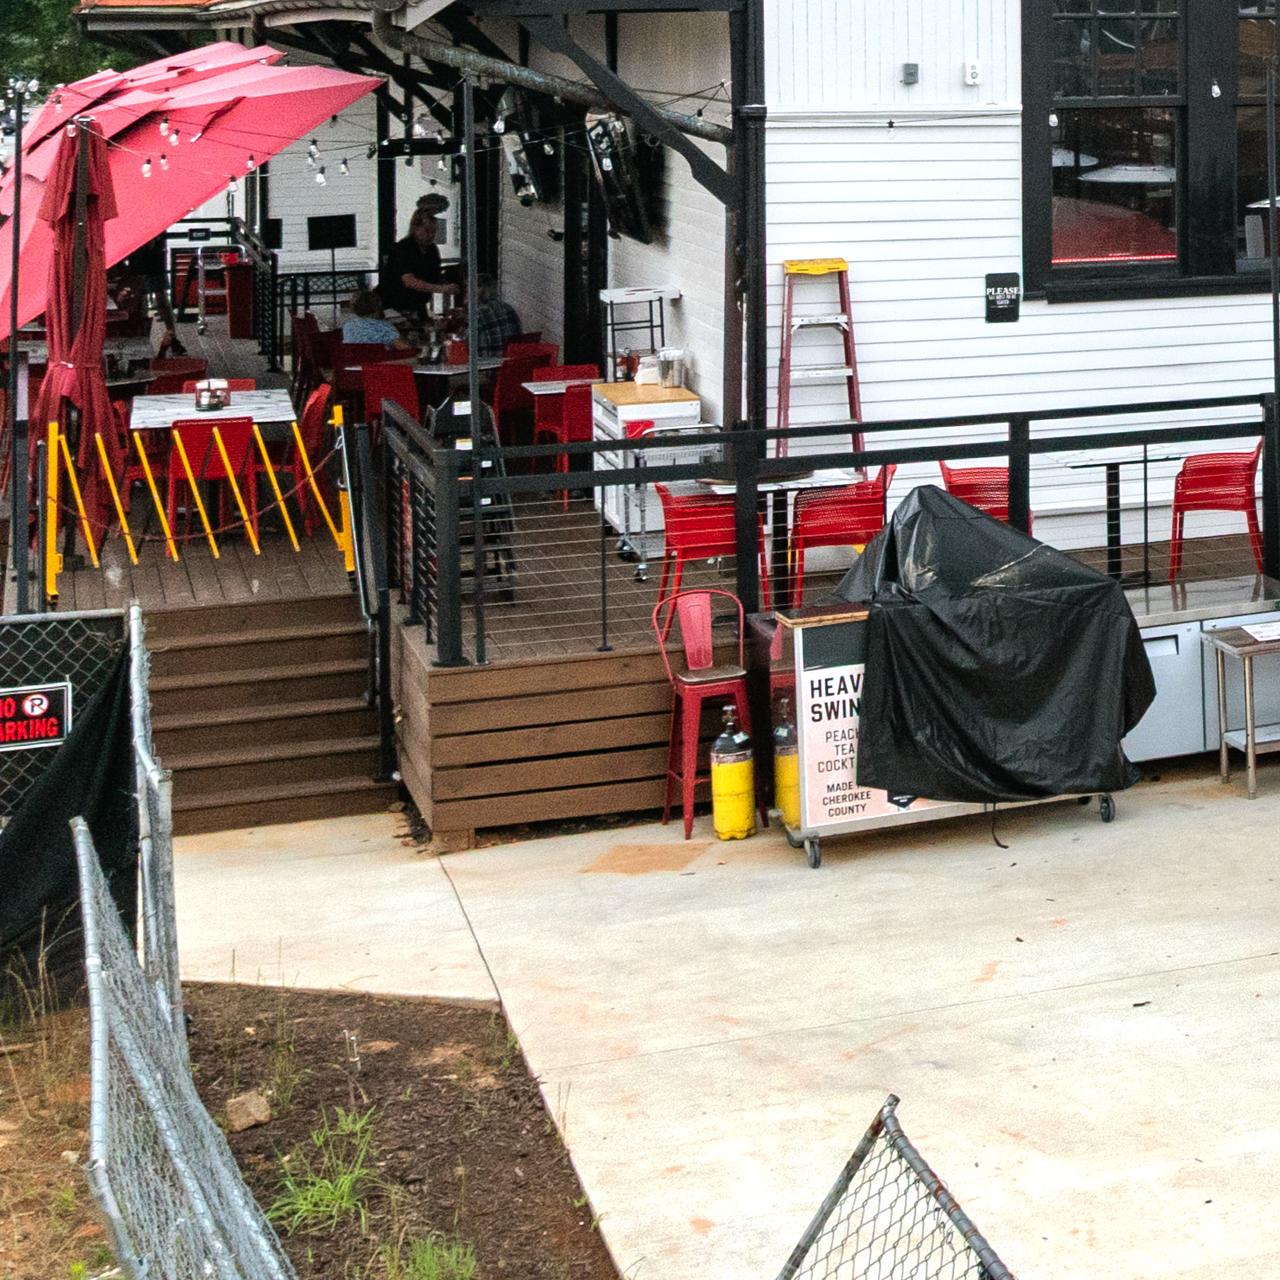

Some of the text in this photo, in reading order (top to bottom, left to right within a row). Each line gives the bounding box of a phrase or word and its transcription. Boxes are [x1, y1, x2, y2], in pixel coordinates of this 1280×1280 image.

[986, 286, 1020, 295] PLEASE
[810, 673, 864, 699] HEAV
[810, 698, 861, 723] SWIN
[0, 717, 58, 741] ARKING
[834, 742, 855, 756] TEA
[817, 757, 855, 773] COCKT
[826, 781, 854, 793] MADE
[822, 791, 872, 806] CHEROKEE
[828, 804, 867, 817] COUNTY
